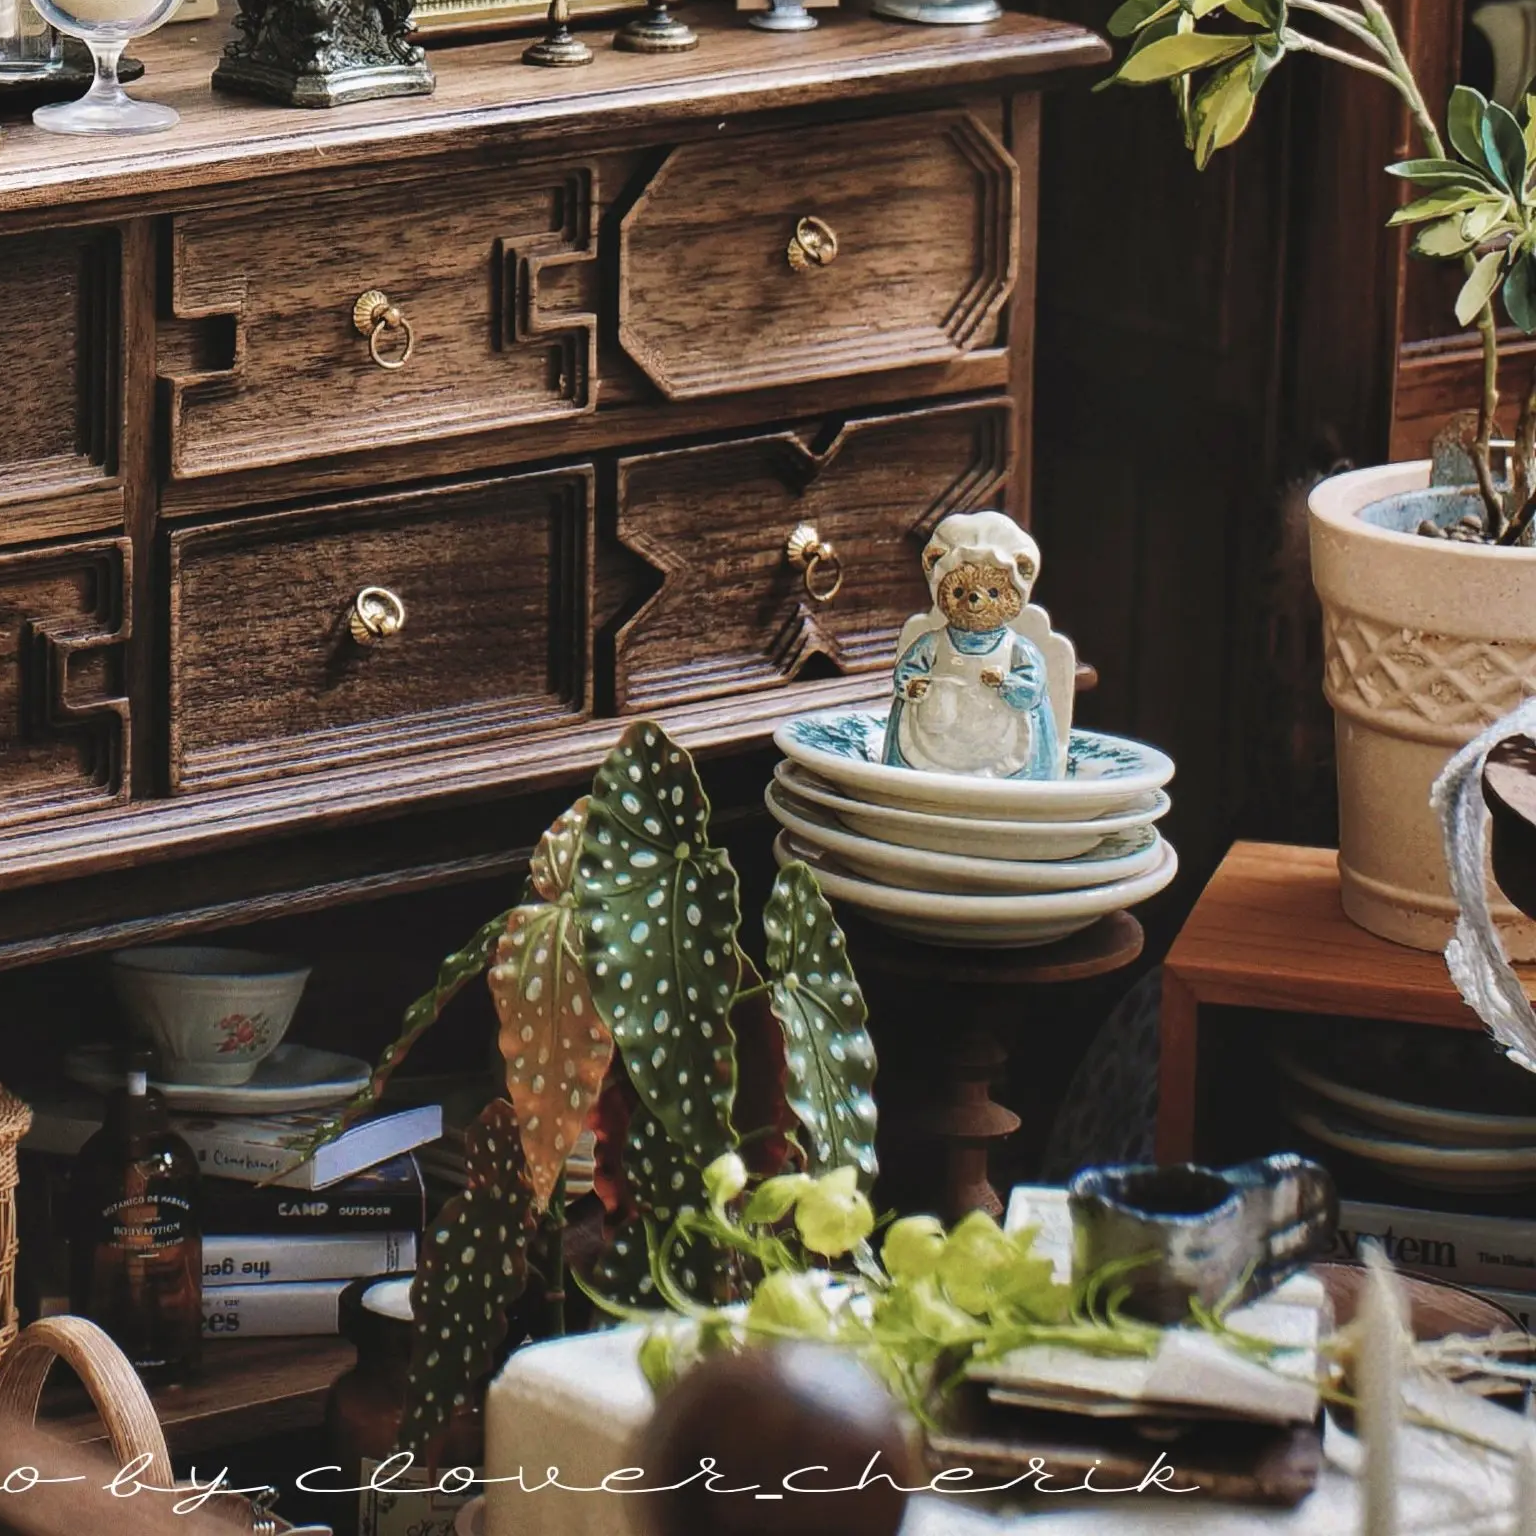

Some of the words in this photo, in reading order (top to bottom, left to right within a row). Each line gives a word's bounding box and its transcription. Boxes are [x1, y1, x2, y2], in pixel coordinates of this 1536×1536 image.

[147, 1195, 159, 1203] DE
[277, 1202, 329, 1216] CAMP
[338, 1206, 392, 1215] OUTDOOR
[113, 1226, 143, 1236] BODY
[144, 1221, 181, 1236] LOTION
[241, 1260, 271, 1279] the
